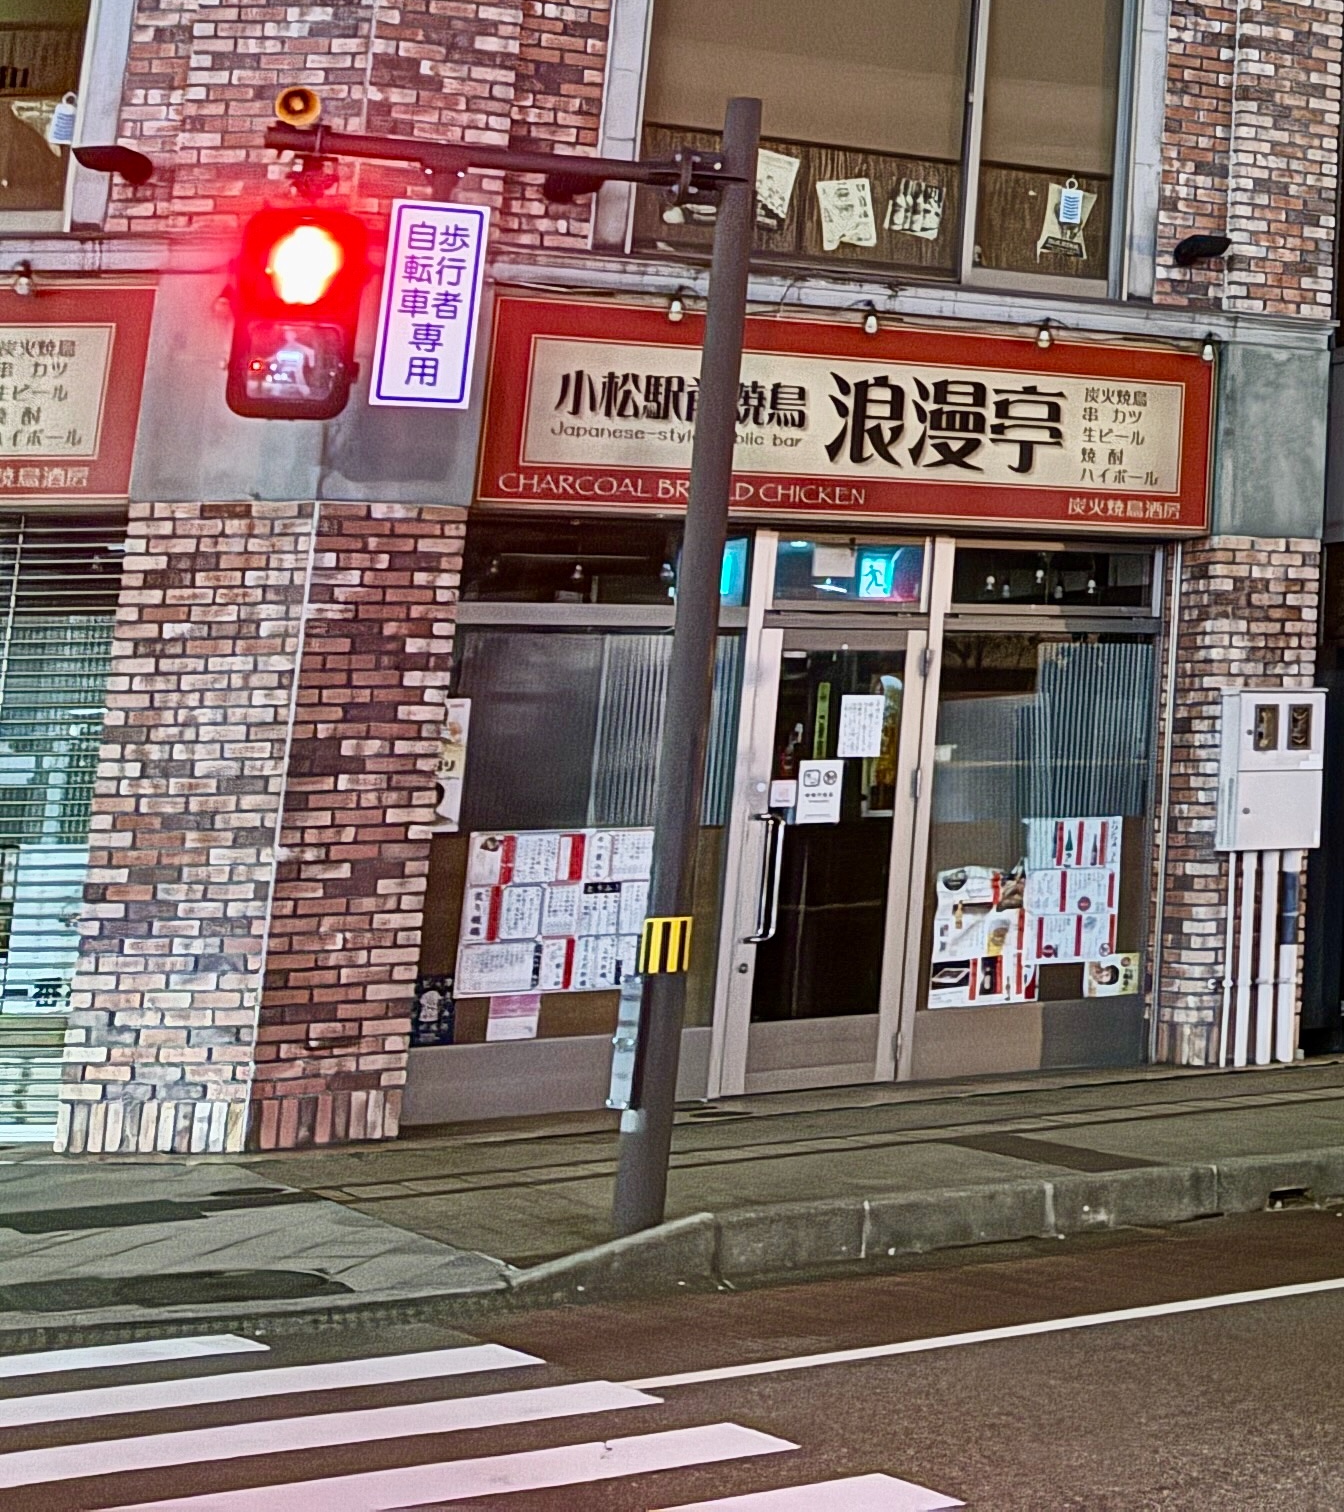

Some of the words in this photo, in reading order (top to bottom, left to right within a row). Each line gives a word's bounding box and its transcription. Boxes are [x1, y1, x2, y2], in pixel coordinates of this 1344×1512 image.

[397, 221, 437, 318] 自転車
[431, 223, 470, 320] 歩行者
[404, 322, 446, 387] 専用
[1084, 387, 1148, 407] 炭火焼鳥
[551, 420, 697, 444] Japanese-styl
[772, 433, 802, 448] bar
[554, 369, 807, 429] 小松駅焼鳥
[825, 371, 1067, 473] 浪漫亭
[0, 428, 82, 447] イボール
[1082, 427, 1145, 446] 生ビール
[498, 472, 651, 497] CHARCOAL
[759, 483, 865, 505] CHICKEN
[1080, 468, 1159, 486] ハイボール
